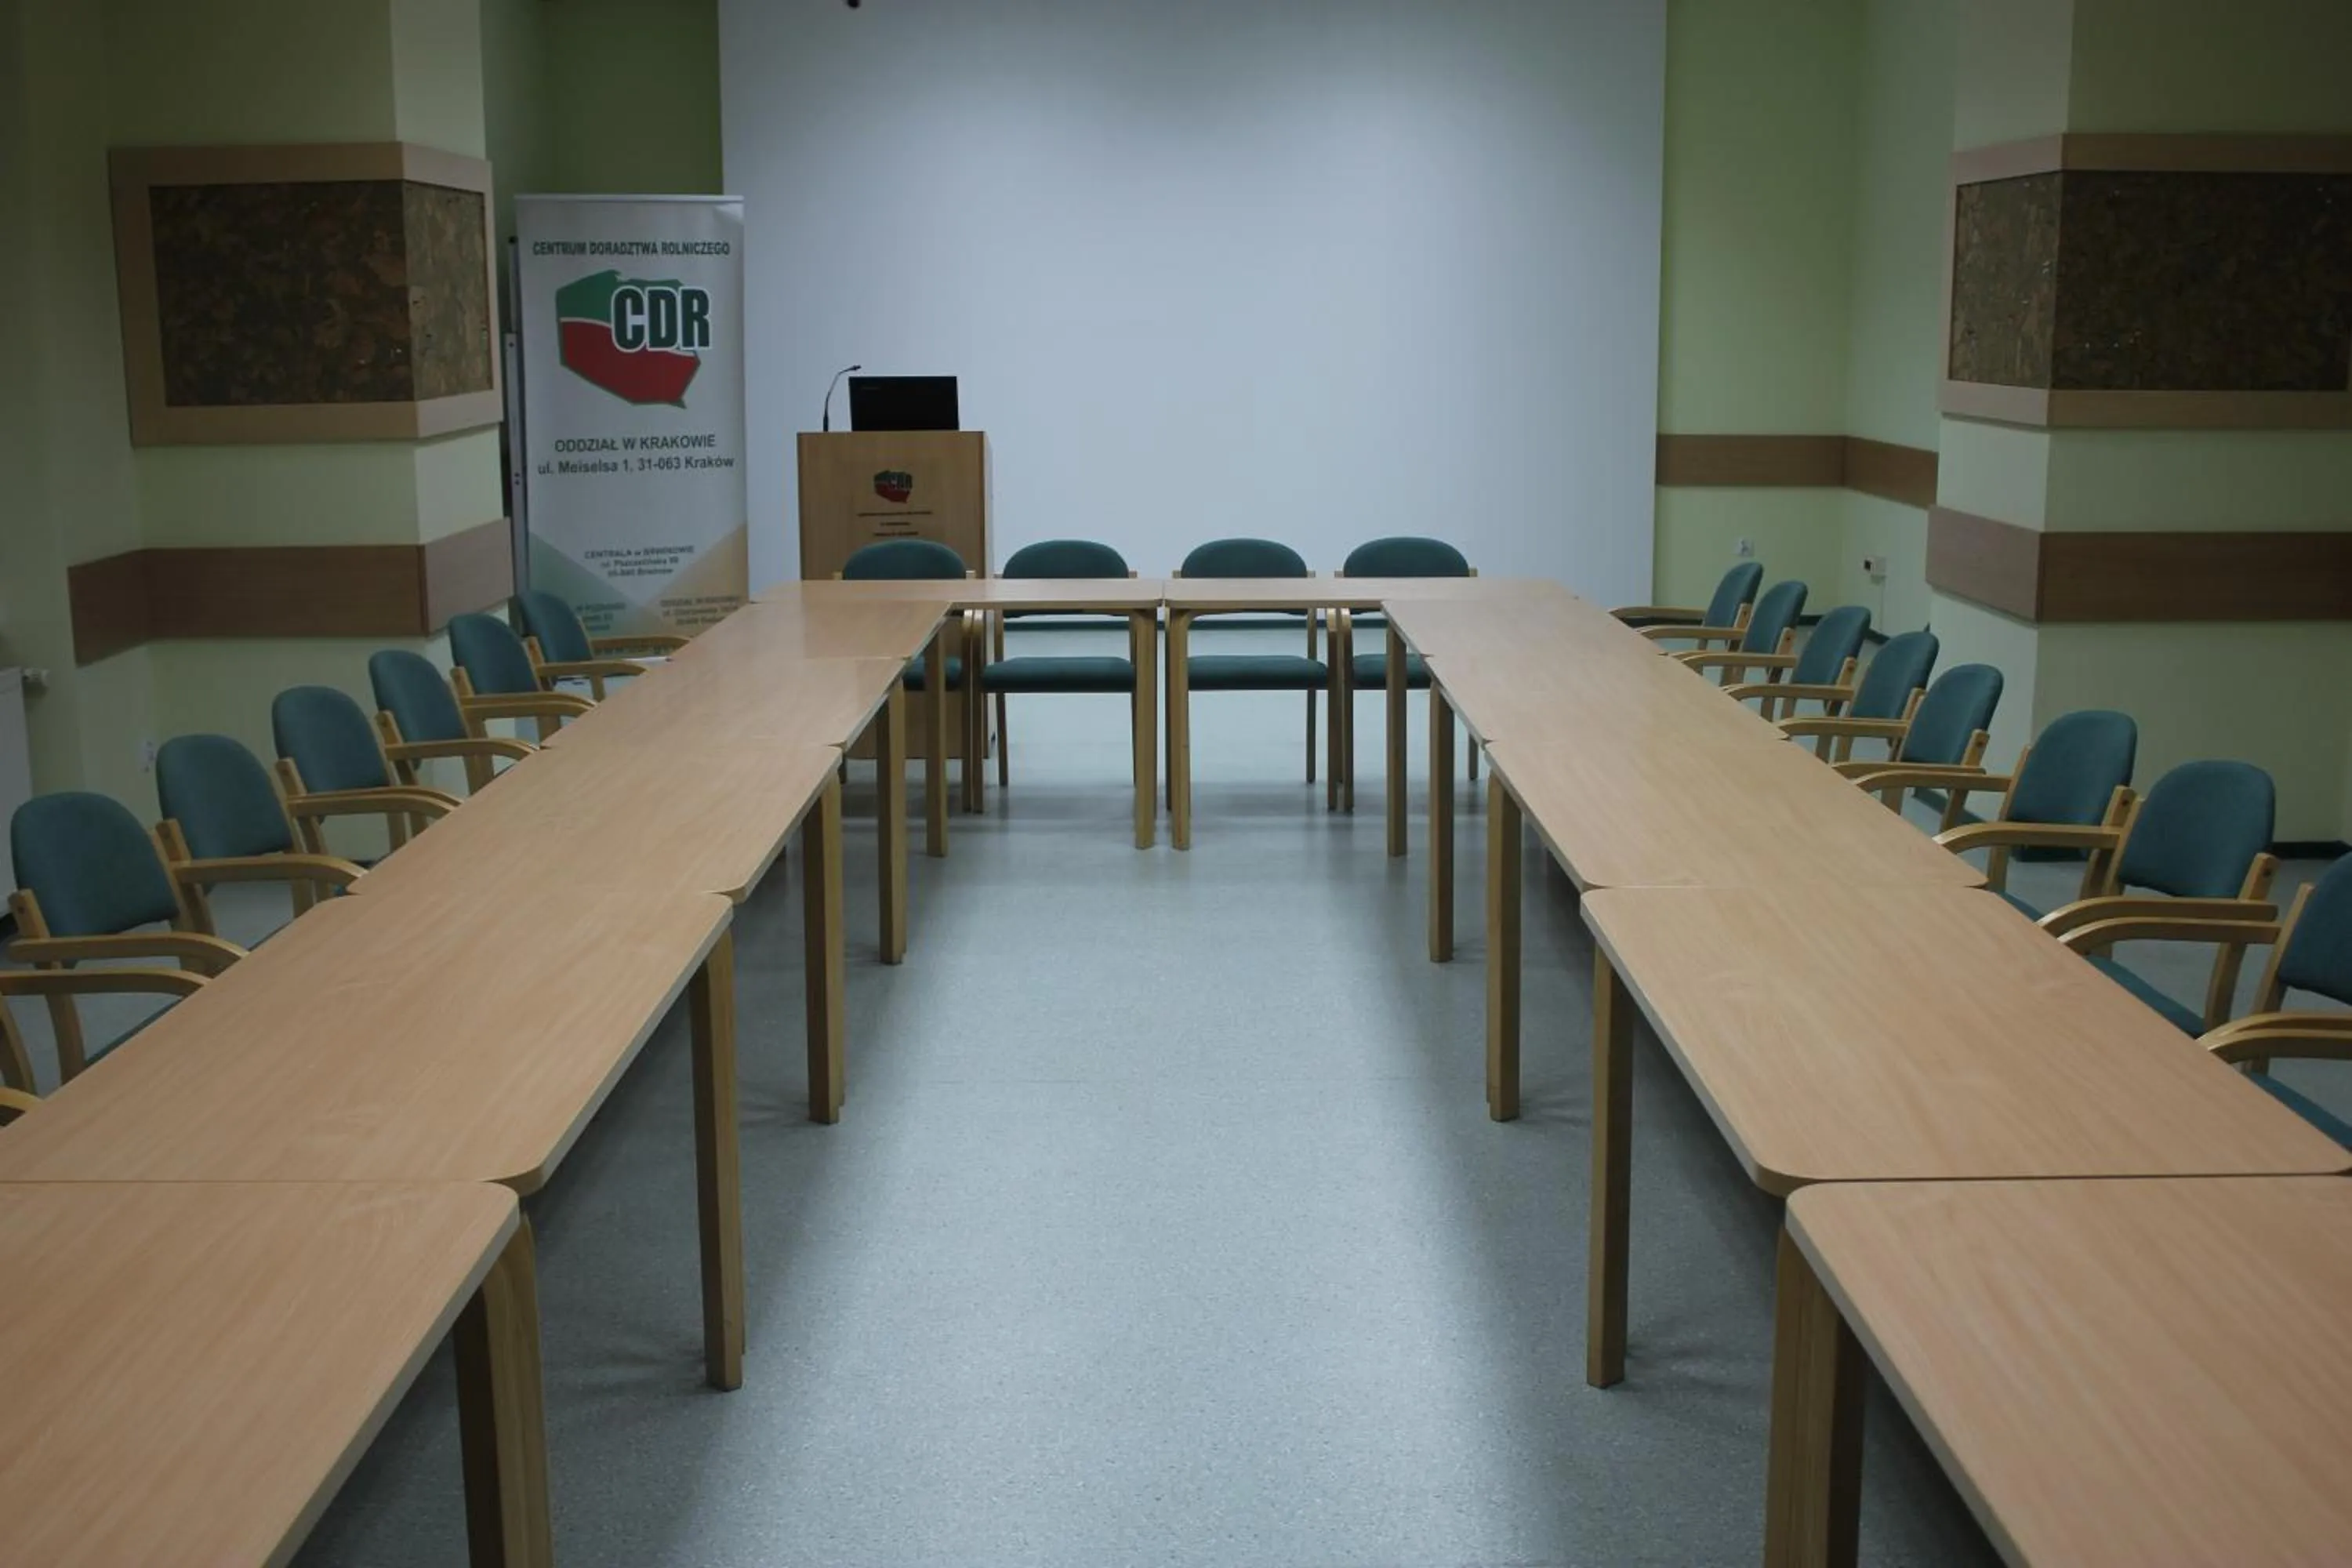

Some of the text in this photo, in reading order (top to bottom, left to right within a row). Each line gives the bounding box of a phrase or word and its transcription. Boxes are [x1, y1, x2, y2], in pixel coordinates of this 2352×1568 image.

[533, 241, 731, 256] CENTRUM DORADZTWA ROLNICZEGO
[612, 287, 710, 350] CDR
[554, 434, 716, 452] ODDZIAŁ W KRAKOWIE
[538, 461, 554, 474] ul.
[558, 459, 619, 474] Meiselsa
[638, 457, 681, 472] 31-063
[684, 456, 735, 470] Kraków
